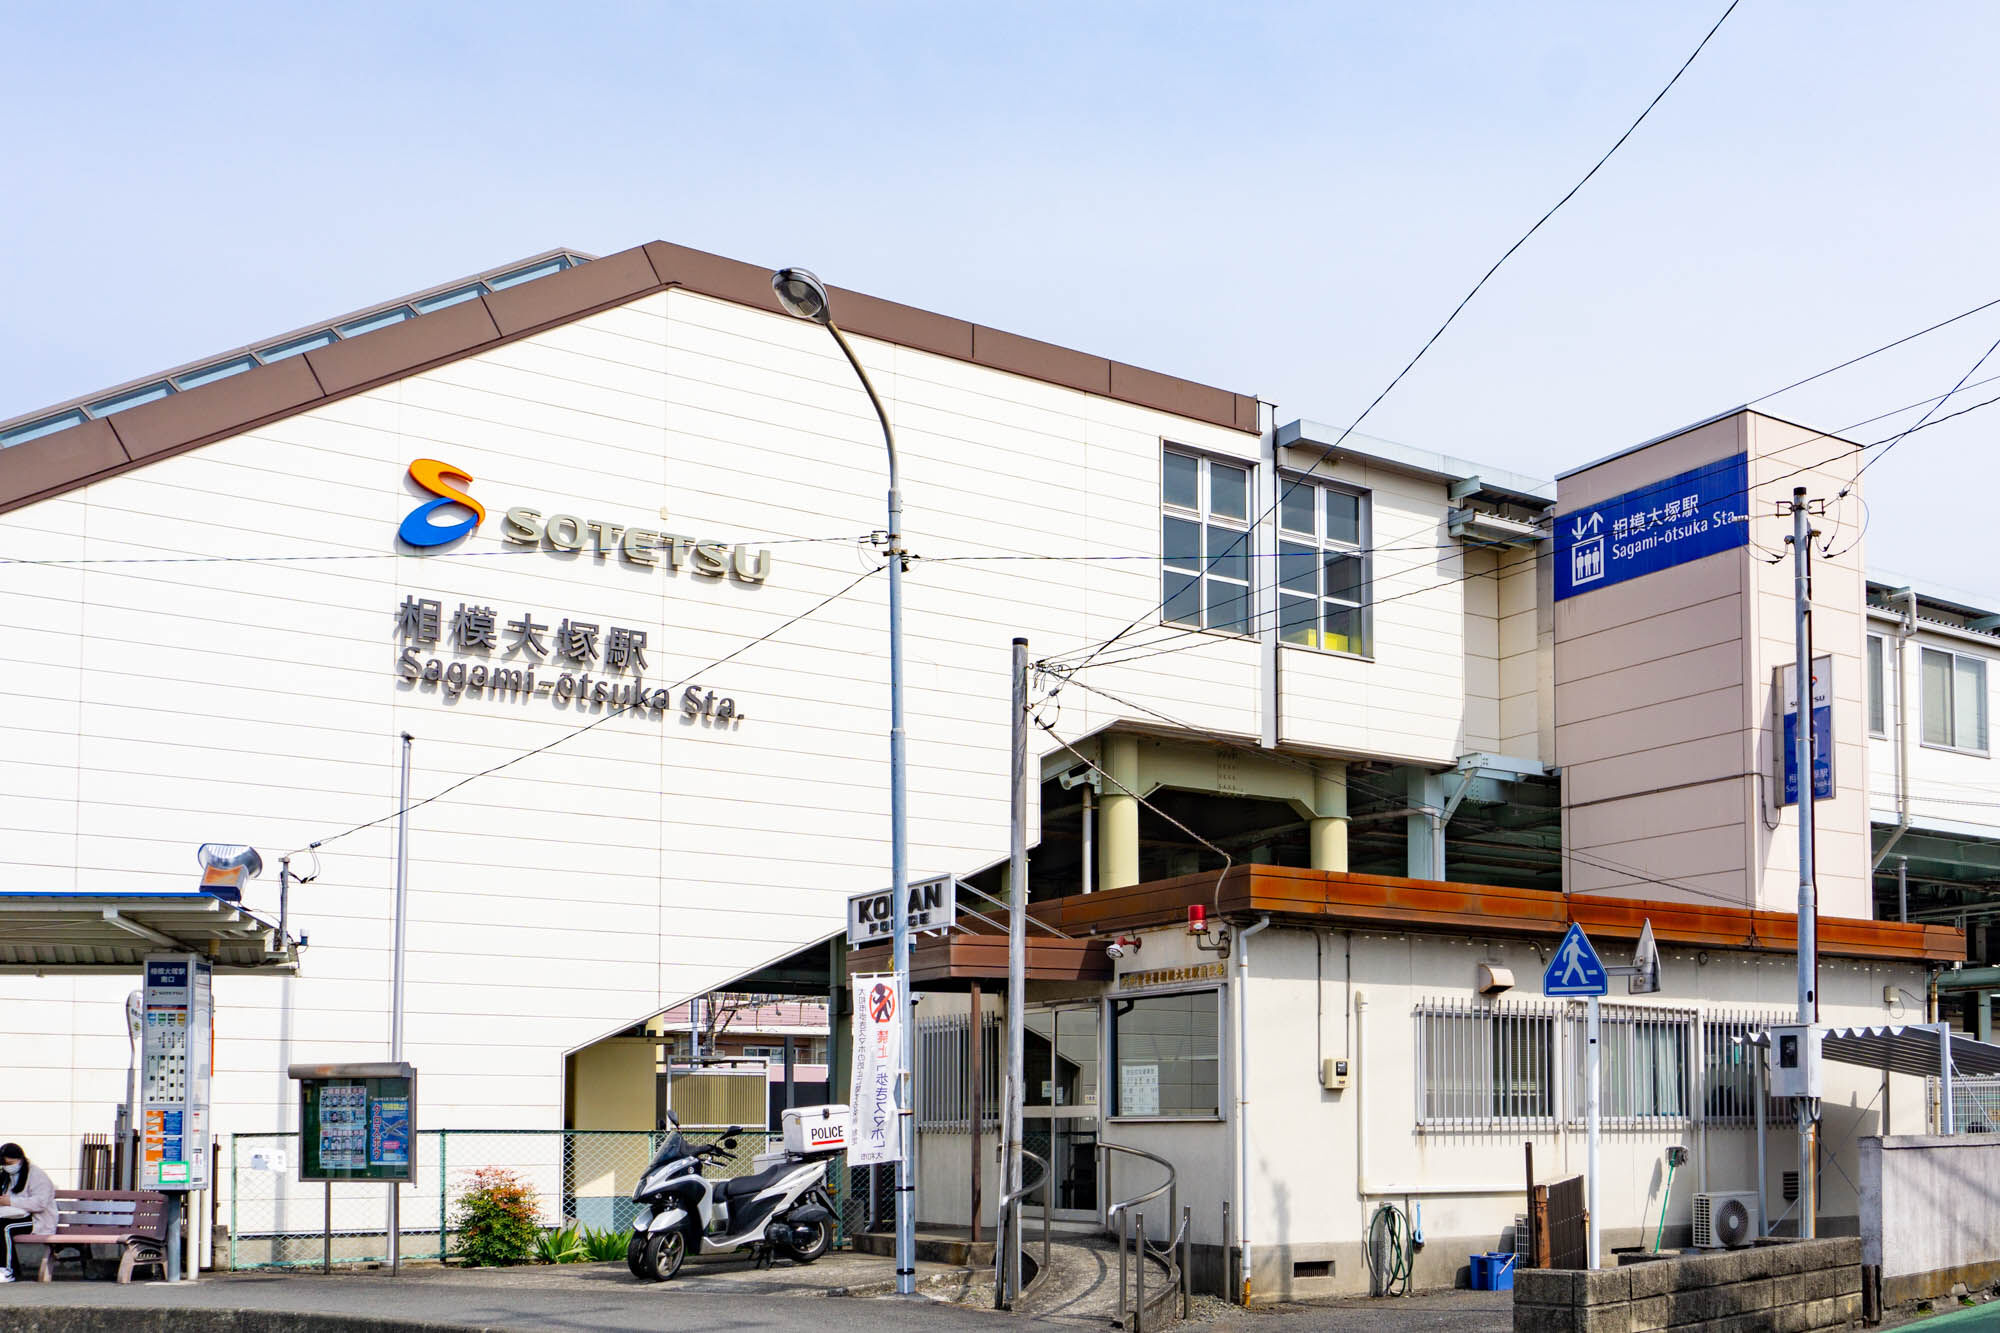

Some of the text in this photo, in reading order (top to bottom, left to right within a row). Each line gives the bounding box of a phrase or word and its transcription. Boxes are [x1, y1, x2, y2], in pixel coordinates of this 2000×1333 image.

[1612, 494, 1699, 540] 相模大塚駅
[1713, 510, 1737, 528] Sta
[505, 506, 771, 581] SOTETSU
[400, 595, 649, 671] 相模大塚駅
[684, 685, 745, 720] Sta.
[858, 883, 942, 924] KOAN
[869, 912, 930, 935] POCE
[811, 1125, 844, 1140] POLICE
